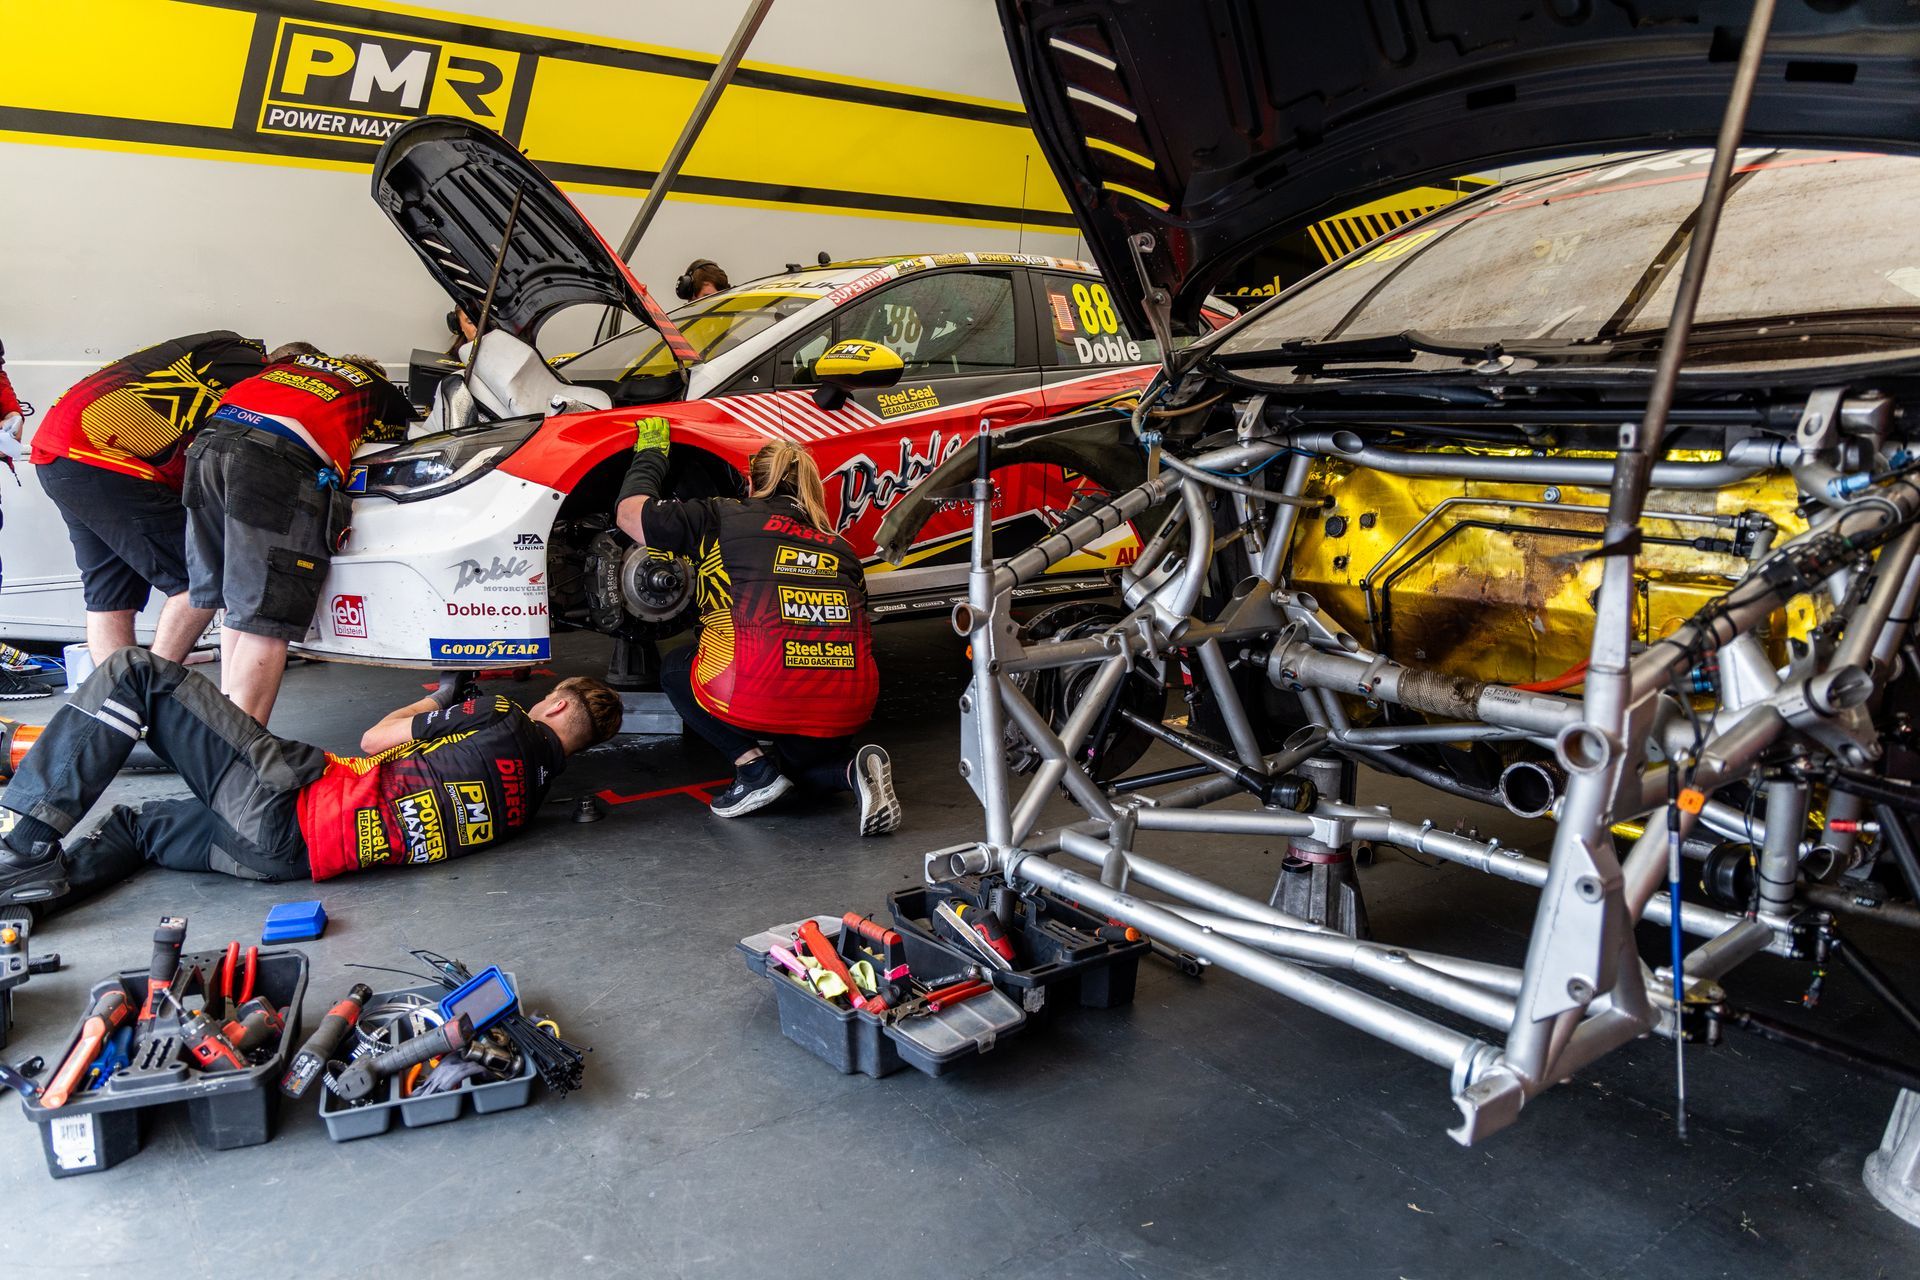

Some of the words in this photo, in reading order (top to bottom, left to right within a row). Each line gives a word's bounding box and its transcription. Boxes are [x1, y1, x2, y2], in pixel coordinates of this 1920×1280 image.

[281, 33, 503, 117] PMR
[268, 108, 346, 133] POWER
[349, 118, 402, 138] MAX
[979, 253, 1011, 263] POWER
[1011, 254, 1046, 265] MAXED
[829, 269, 890, 304] SUPERHUB
[1072, 283, 1118, 335] 88
[830, 345, 877, 356] PMR
[1074, 336, 1141, 364] Doble
[298, 355, 362, 384] MAXED
[271, 370, 309, 384] Steel
[308, 378, 341, 398] Seal
[877, 390, 909, 407] Steel
[909, 385, 935, 400] Seal
[237, 411, 263, 425] ONE
[883, 406, 901, 416] HEAD
[902, 401, 926, 412] GASKET
[927, 399, 938, 407] FIX
[513, 534, 544, 544] JFA
[763, 519, 837, 545] DIRECT
[779, 549, 836, 570] PMR
[445, 556, 534, 594] Doble
[446, 602, 548, 616] Doble.co.uk
[782, 589, 845, 606] POWER
[332, 597, 363, 625] febi
[784, 603, 847, 622] MAXED
[338, 625, 363, 635] bilstein
[441, 643, 539, 655] GOODYEAR
[785, 641, 823, 656] Steel
[825, 642, 854, 656] Seal
[787, 657, 810, 665] HEAD
[811, 658, 840, 666] GASKET
[842, 658, 854, 666] FIX
[447, 785, 461, 806] POWER
[457, 805, 465, 824] MAXED
[496, 759, 522, 826] DIRECT
[360, 811, 369, 837] HEAD
[460, 785, 489, 841] PMR
[400, 799, 429, 863] MAXED
[414, 794, 443, 862] POWER
